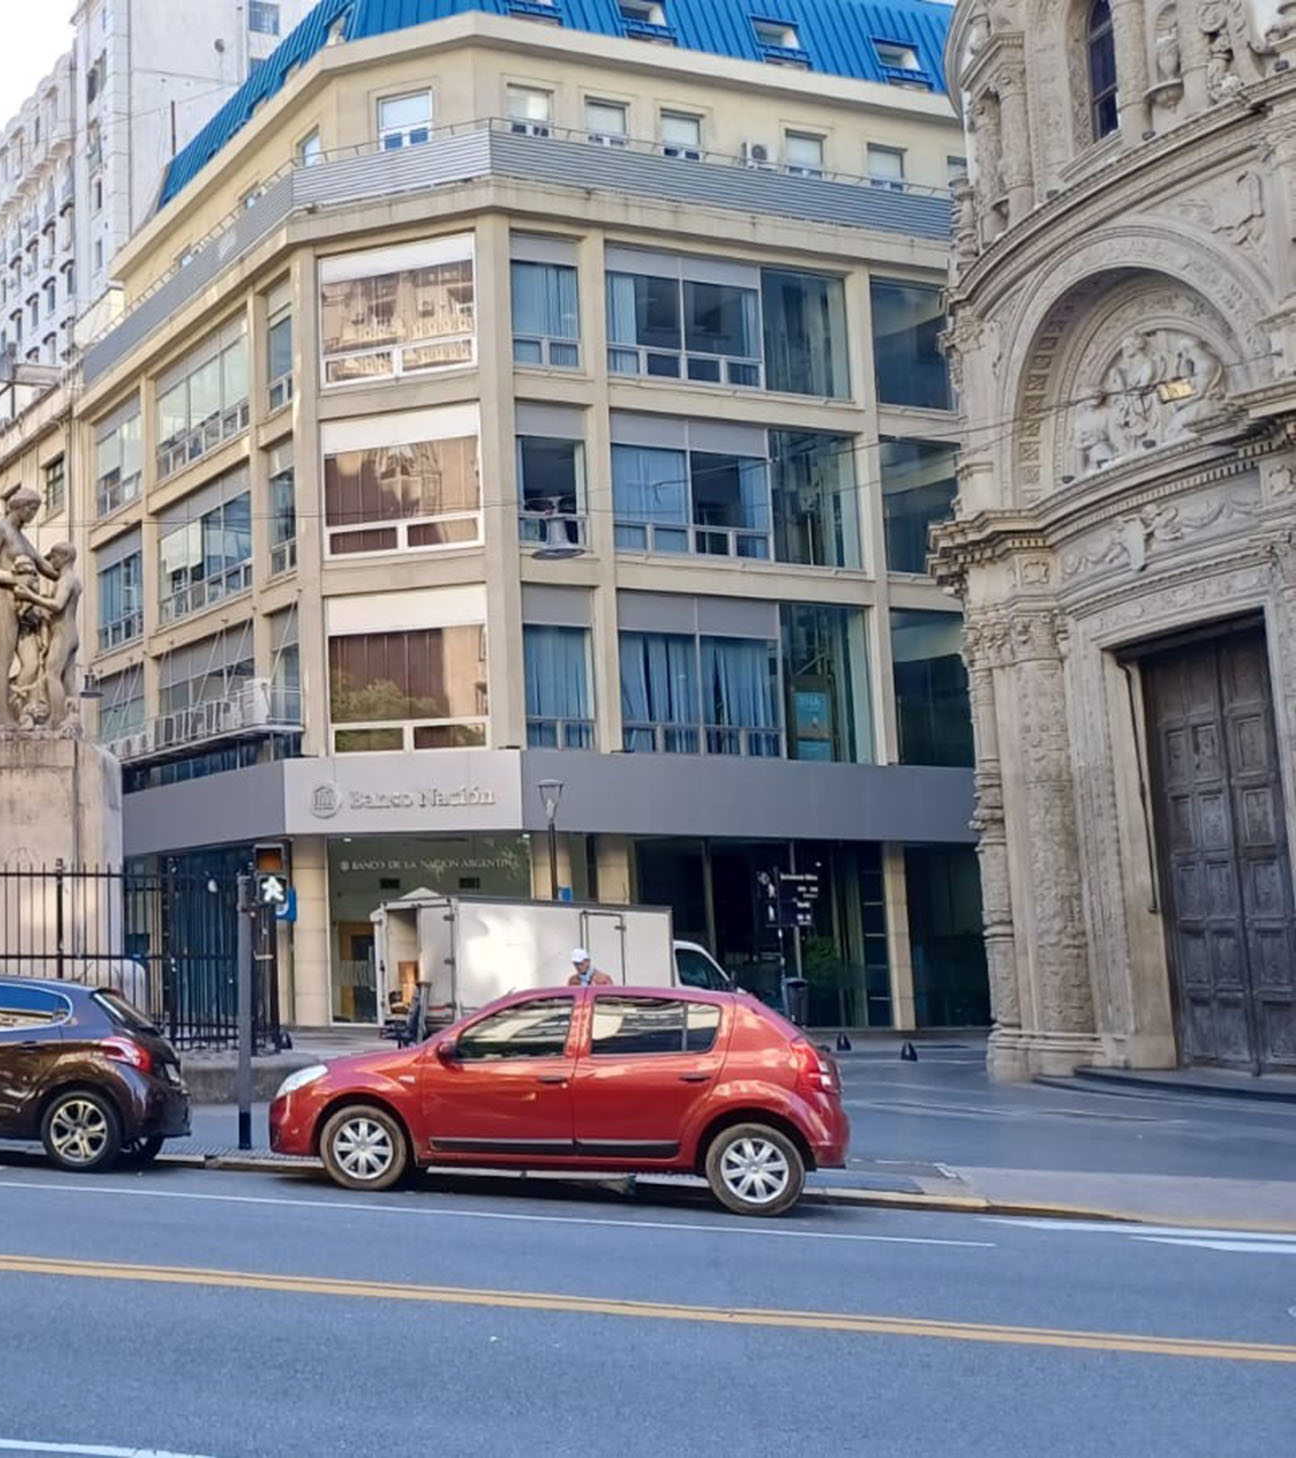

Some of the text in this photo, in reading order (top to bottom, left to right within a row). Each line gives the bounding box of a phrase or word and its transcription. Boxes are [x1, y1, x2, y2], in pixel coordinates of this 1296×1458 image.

[350, 785, 496, 809] Banco Nación
[352, 860, 385, 870] BANCO
